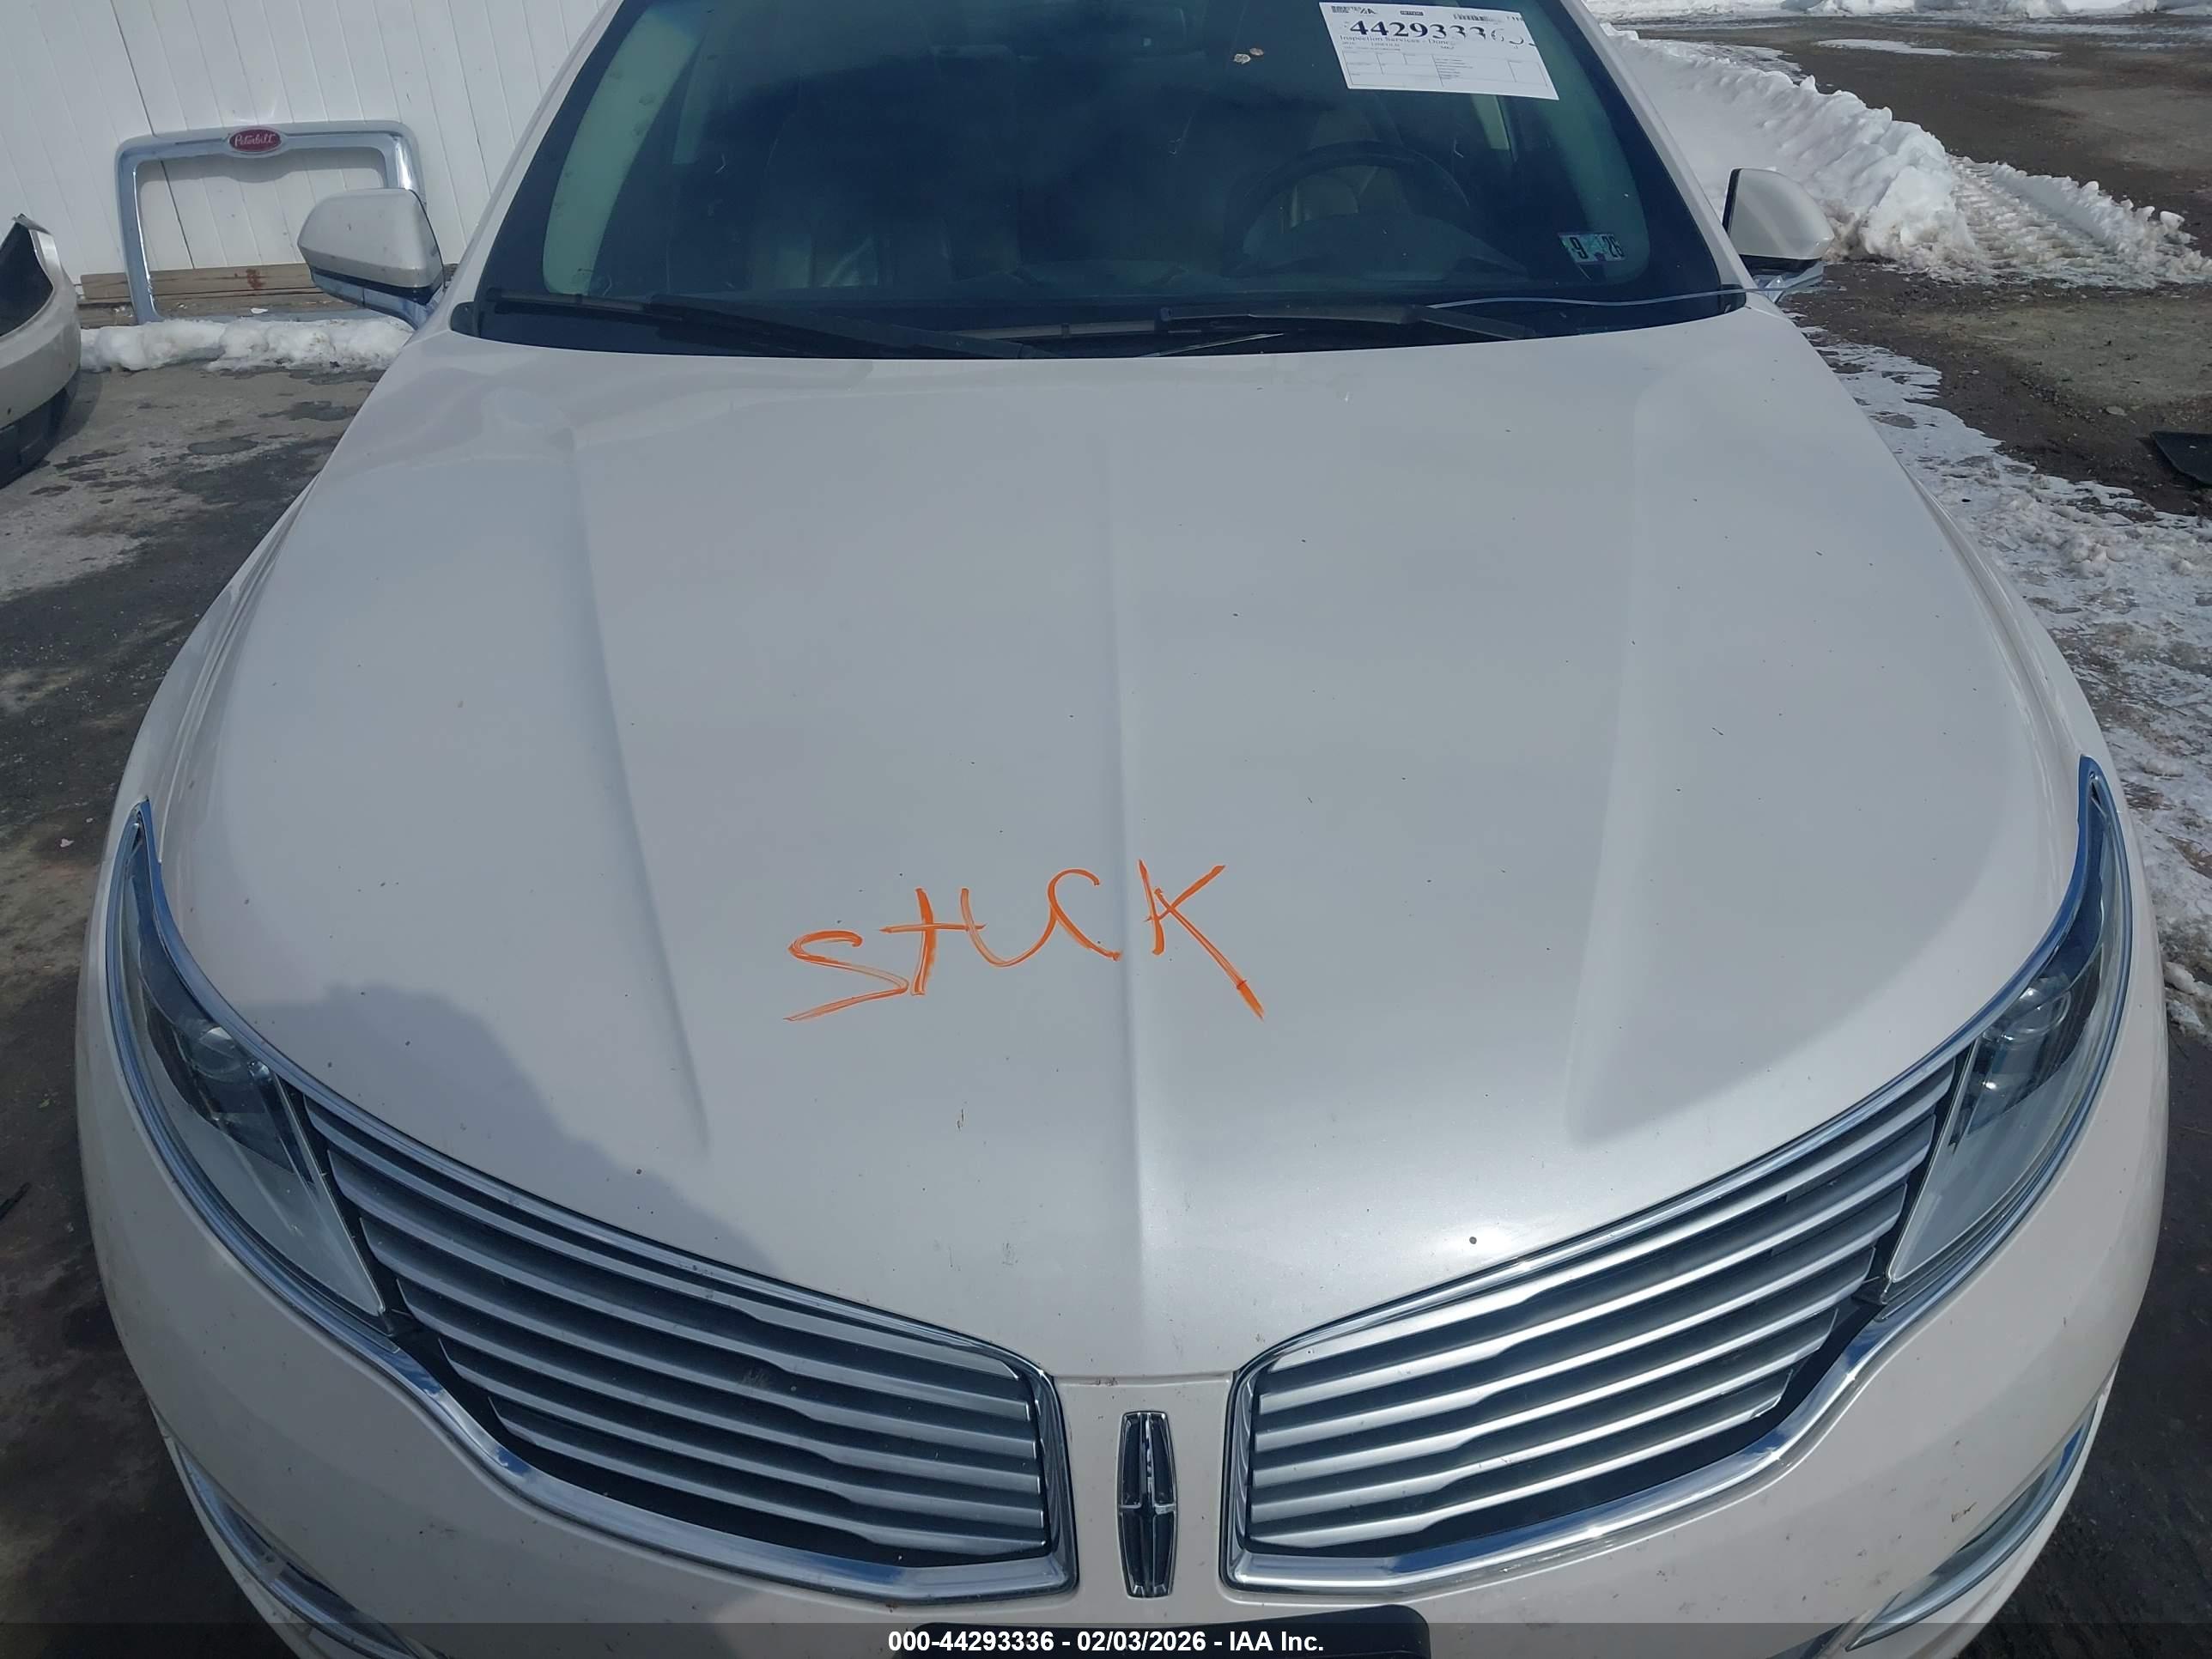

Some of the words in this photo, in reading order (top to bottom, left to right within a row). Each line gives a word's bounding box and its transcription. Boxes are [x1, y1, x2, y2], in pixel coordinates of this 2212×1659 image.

[234, 133, 276, 147] Peterbilt
[1570, 237, 1589, 258] 9
[1601, 235, 1625, 258] 26
[783, 860, 1264, 1020] STUCK
